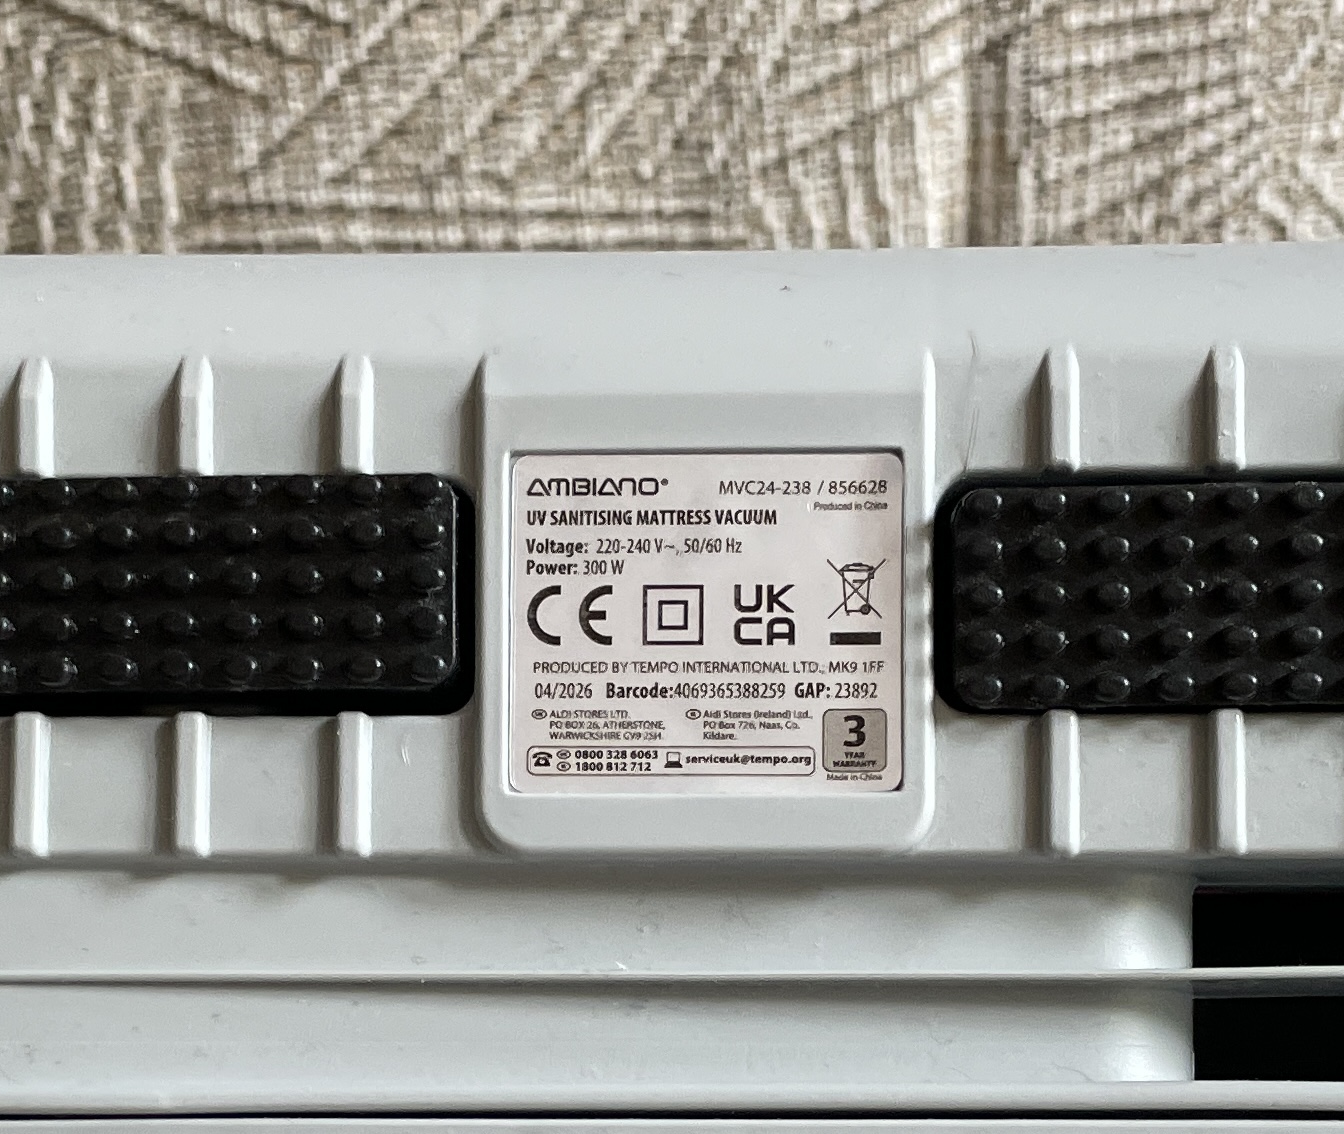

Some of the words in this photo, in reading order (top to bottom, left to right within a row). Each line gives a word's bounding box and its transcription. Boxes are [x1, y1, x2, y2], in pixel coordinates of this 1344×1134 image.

[526, 477, 659, 496] AMBIANO
[718, 480, 811, 495] MVC24-238
[816, 480, 825, 495] /
[828, 479, 887, 494] 856628
[813, 501, 852, 511] Produced
[854, 502, 862, 511] in
[863, 501, 888, 511] China
[526, 510, 547, 526] UV
[549, 510, 633, 526] SANITISING
[636, 510, 712, 526] MATTRESS
[714, 509, 778, 525] VACUUM
[525, 538, 589, 557] Voltage:
[596, 538, 651, 554] 220-240
[683, 538, 722, 554] 50/60
[725, 538, 743, 554] Hz
[525, 559, 578, 575] Power:
[582, 559, 607, 575] 300
[610, 560, 625, 575] W
[733, 584, 795, 613] UK
[526, 584, 613, 645] CE
[733, 616, 796, 646] CA
[533, 661, 609, 674] PRODUCED
[611, 661, 630, 674] BY
[631, 661, 679, 674] TEMPO
[682, 661, 790, 674] INTERNATIONAL
[828, 660, 858, 673] MK9
[862, 660, 885, 673] 1FF
[535, 682, 593, 700] 04/2026
[794, 682, 831, 699] GAP:
[834, 682, 879, 699] 23892
[549, 709, 572, 719] ALDI
[573, 709, 609, 719] STORES
[702, 709, 722, 719] Aldi
[723, 709, 752, 719] Stores
[753, 709, 792, 720] (Ireland)
[549, 720, 563, 730] PO
[564, 720, 586, 730] BOX
[702, 720, 717, 730] PO
[718, 720, 736, 730] Box
[843, 714, 867, 747] 3
[549, 731, 622, 740] WARWICKSHIRE
[574, 750, 604, 760] 0800
[606, 750, 627, 760] 328
[629, 750, 659, 760] 6063
[685, 754, 812, 766] serviceuk@tempo.org
[575, 761, 604, 772] 1800
[605, 761, 628, 772] 812
[630, 761, 652, 772] 712
[832, 760, 877, 768] WARRANTY
[826, 773, 849, 781] Made
[859, 773, 883, 781] China
